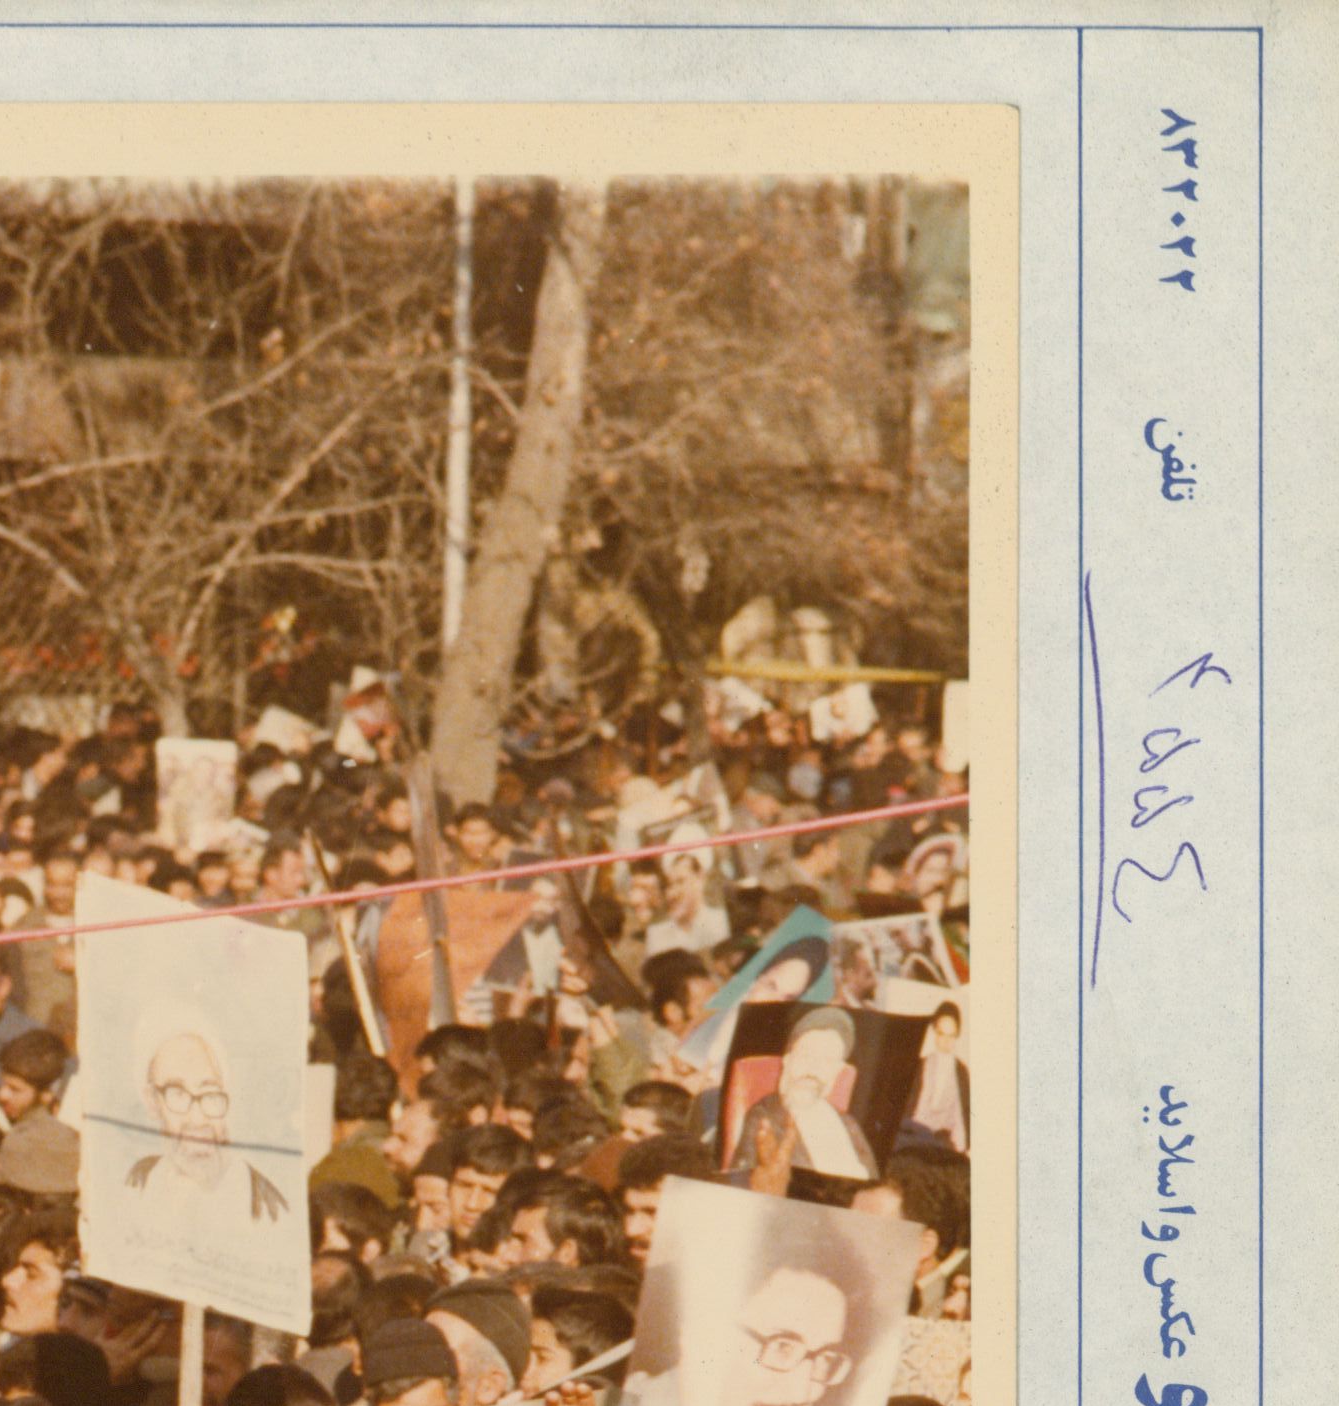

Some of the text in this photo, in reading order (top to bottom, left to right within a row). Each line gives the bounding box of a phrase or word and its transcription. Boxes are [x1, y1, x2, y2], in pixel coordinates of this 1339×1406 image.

[1160, 107, 1199, 293] ۸۳۲۰۲۲
[1145, 418, 1199, 502] تلفن
[1143, 1085, 1195, 1213] اسلاید
[1142, 1220, 1176, 1243] و
[1144, 1252, 1195, 1361] عکس
